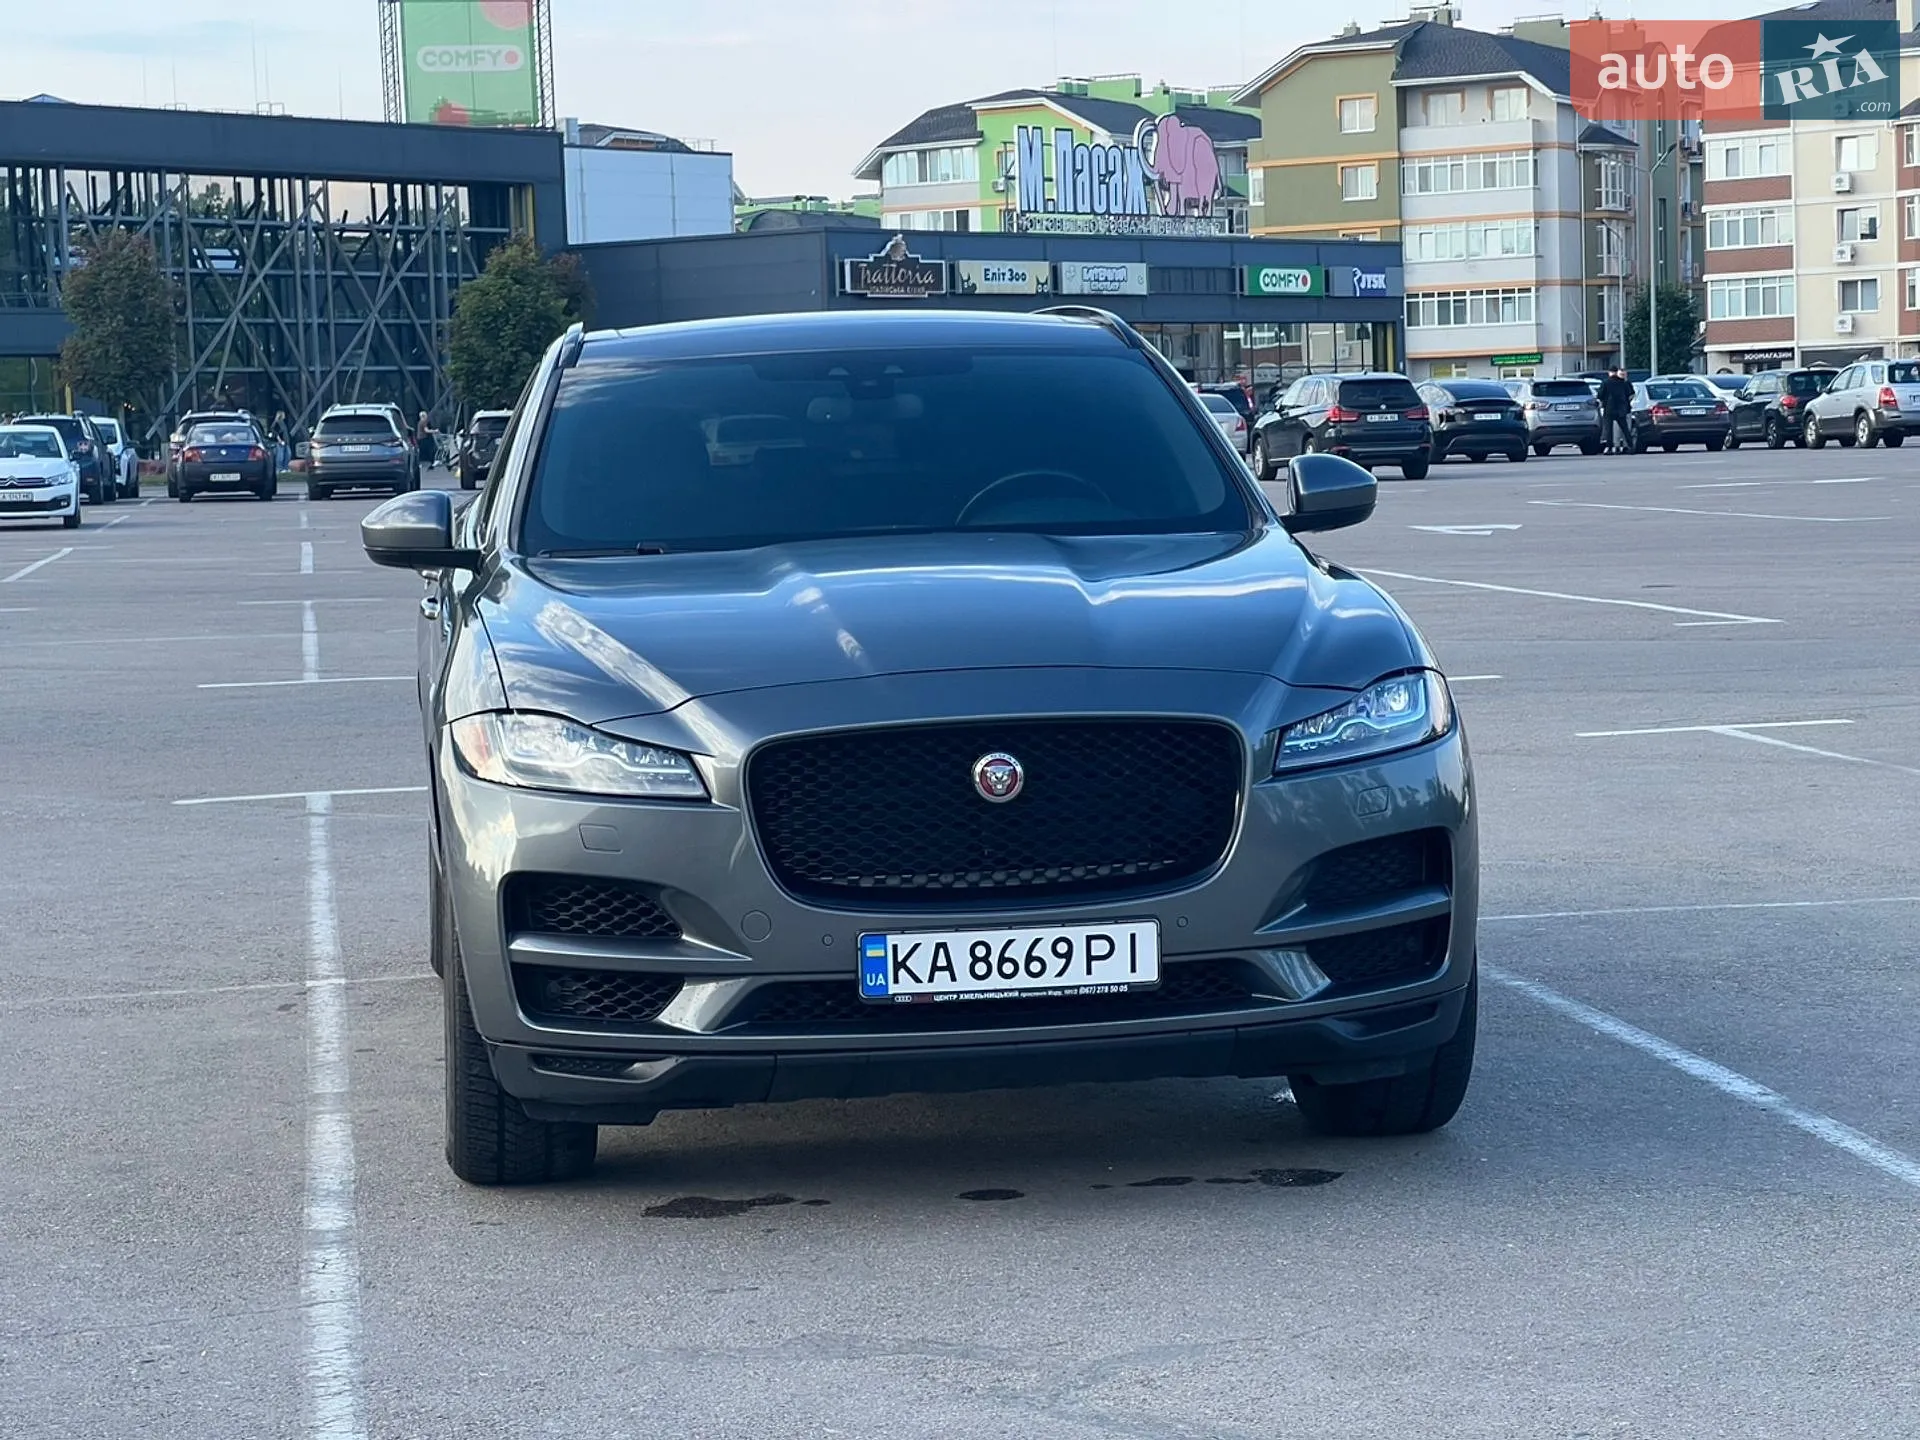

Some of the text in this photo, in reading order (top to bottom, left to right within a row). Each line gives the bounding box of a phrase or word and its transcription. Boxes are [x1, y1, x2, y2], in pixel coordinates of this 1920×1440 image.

[422, 50, 503, 67] COMFY
[858, 263, 936, 288] Trattoria
[984, 267, 1027, 282] Еліт Зоо
[1262, 273, 1300, 288] COMFY
[1360, 273, 1387, 289] JYSK
[1743, 352, 1792, 360] ЗООМАГАЗИН
[891, 932, 1137, 985] KA 8669 PI
[866, 973, 886, 987] UA
